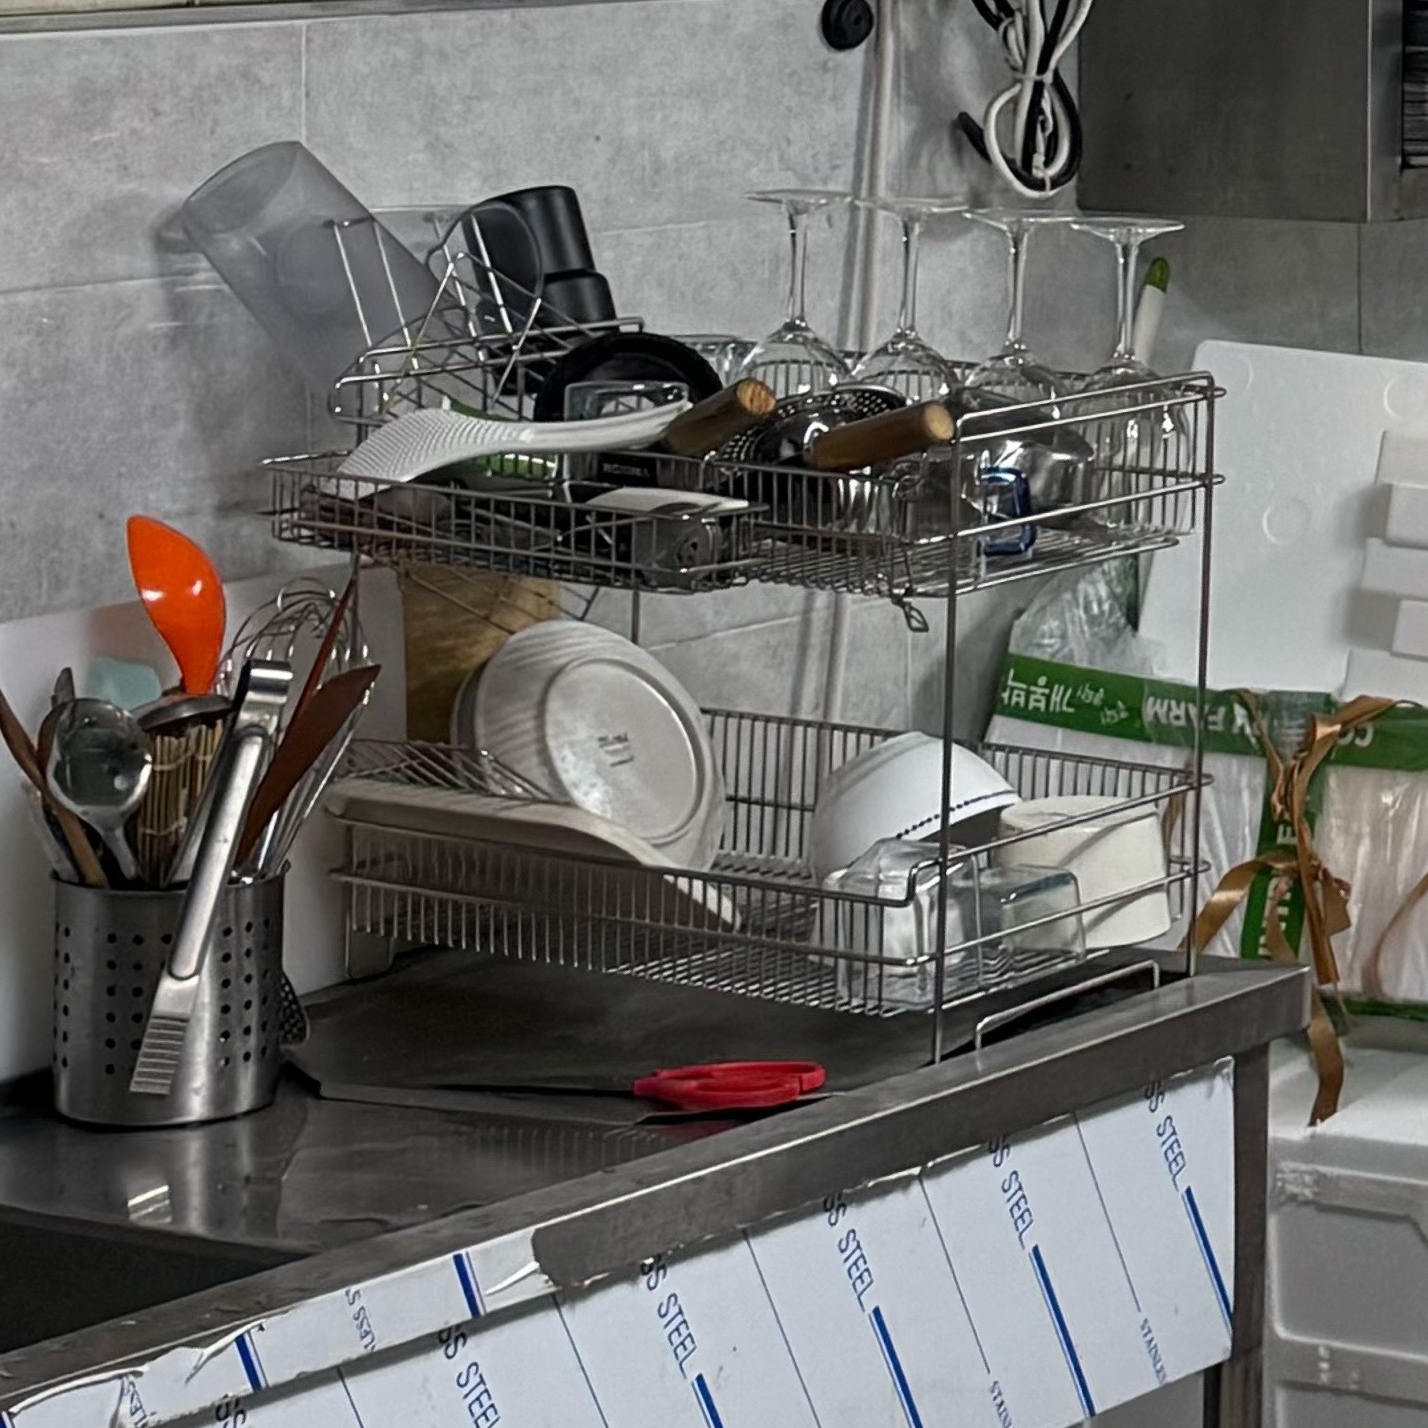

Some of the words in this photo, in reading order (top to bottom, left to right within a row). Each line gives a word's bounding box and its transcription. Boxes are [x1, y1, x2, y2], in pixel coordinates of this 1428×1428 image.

[1001, 670, 1076, 714] 개봉박
[1157, 1115, 1188, 1193] STEEL
[1001, 1169, 1035, 1251] STEEL
[838, 1228, 875, 1314] STEEL
[658, 1292, 700, 1379] STEEL
[1139, 1317, 1169, 1385] STAINLES
